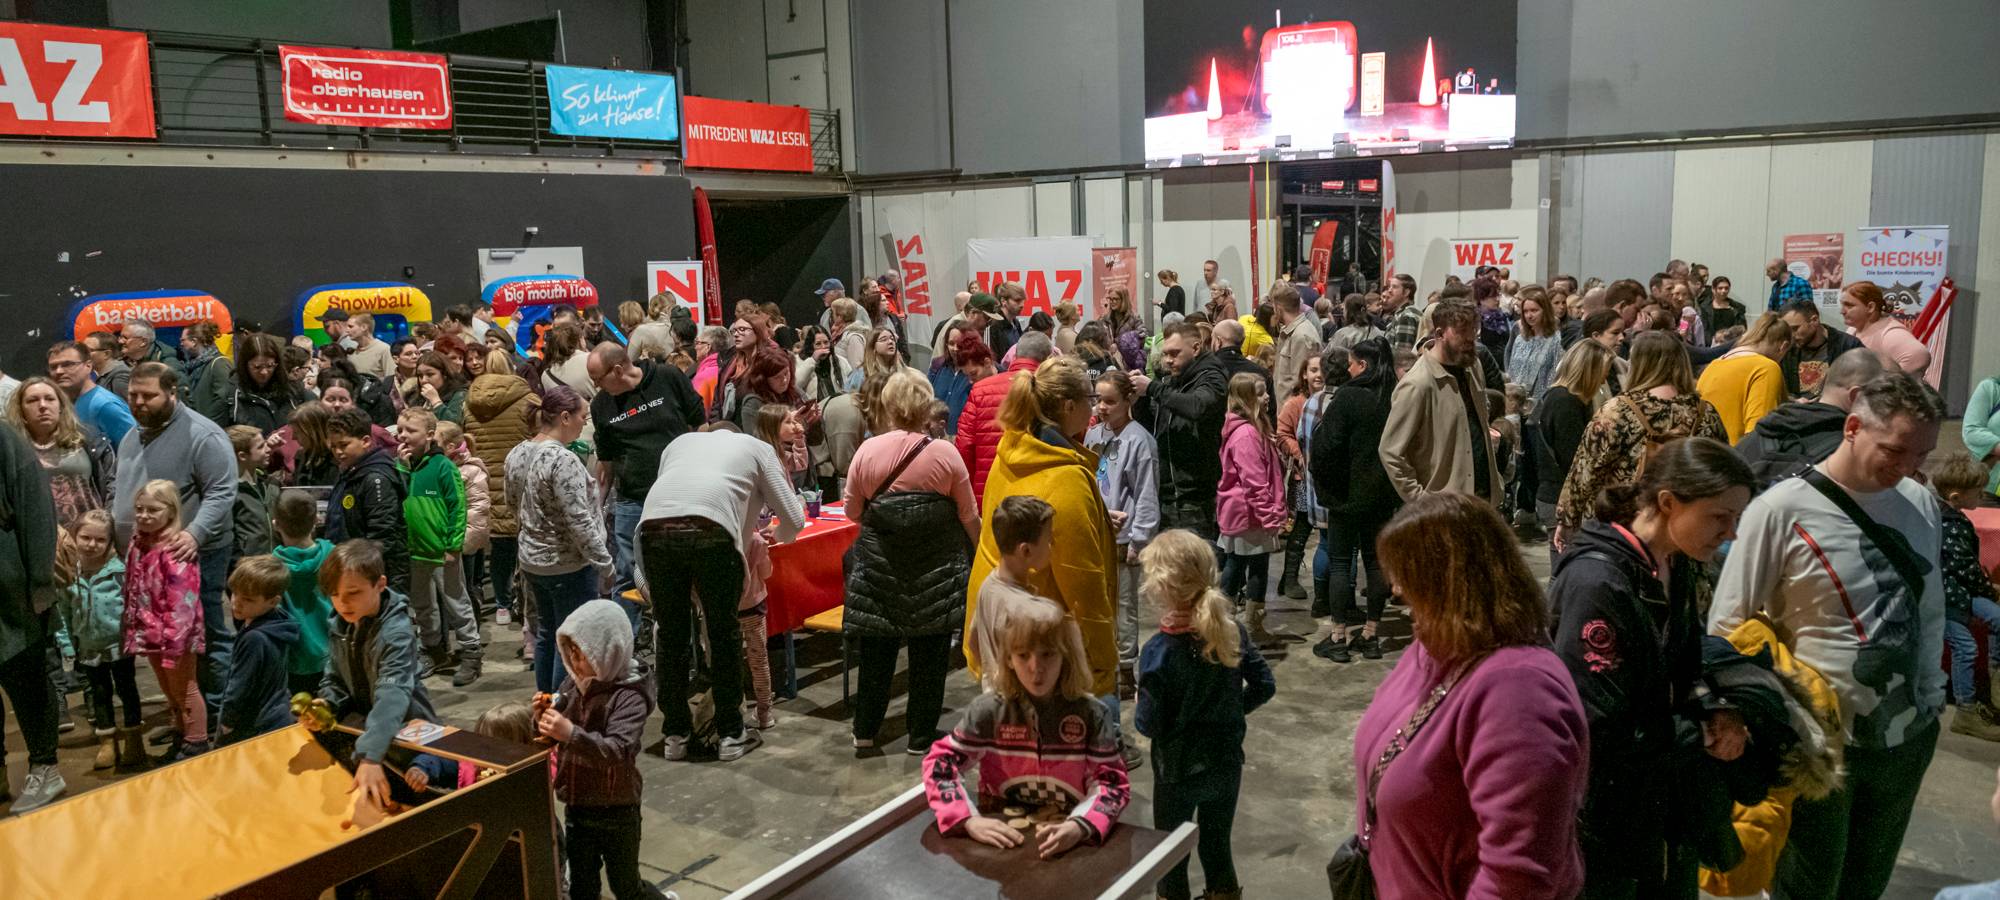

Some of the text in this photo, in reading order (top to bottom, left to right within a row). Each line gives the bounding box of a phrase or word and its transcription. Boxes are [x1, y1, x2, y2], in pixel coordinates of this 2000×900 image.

[311, 67, 363, 81] radio
[311, 82, 424, 101] oberhausen
[562, 82, 647, 112] So klingt
[577, 96, 664, 128] zu Hause!
[688, 123, 809, 147] MITREDEN! WAZ LESEN.
[1455, 242, 1514, 266] WAZ
[1861, 251, 1943, 267] CHECKY!
[328, 292, 413, 311] Snowball
[504, 288, 524, 304] big
[528, 283, 567, 301] mouth
[976, 270, 1084, 317] WAZ
[93, 302, 214, 326] basketball
